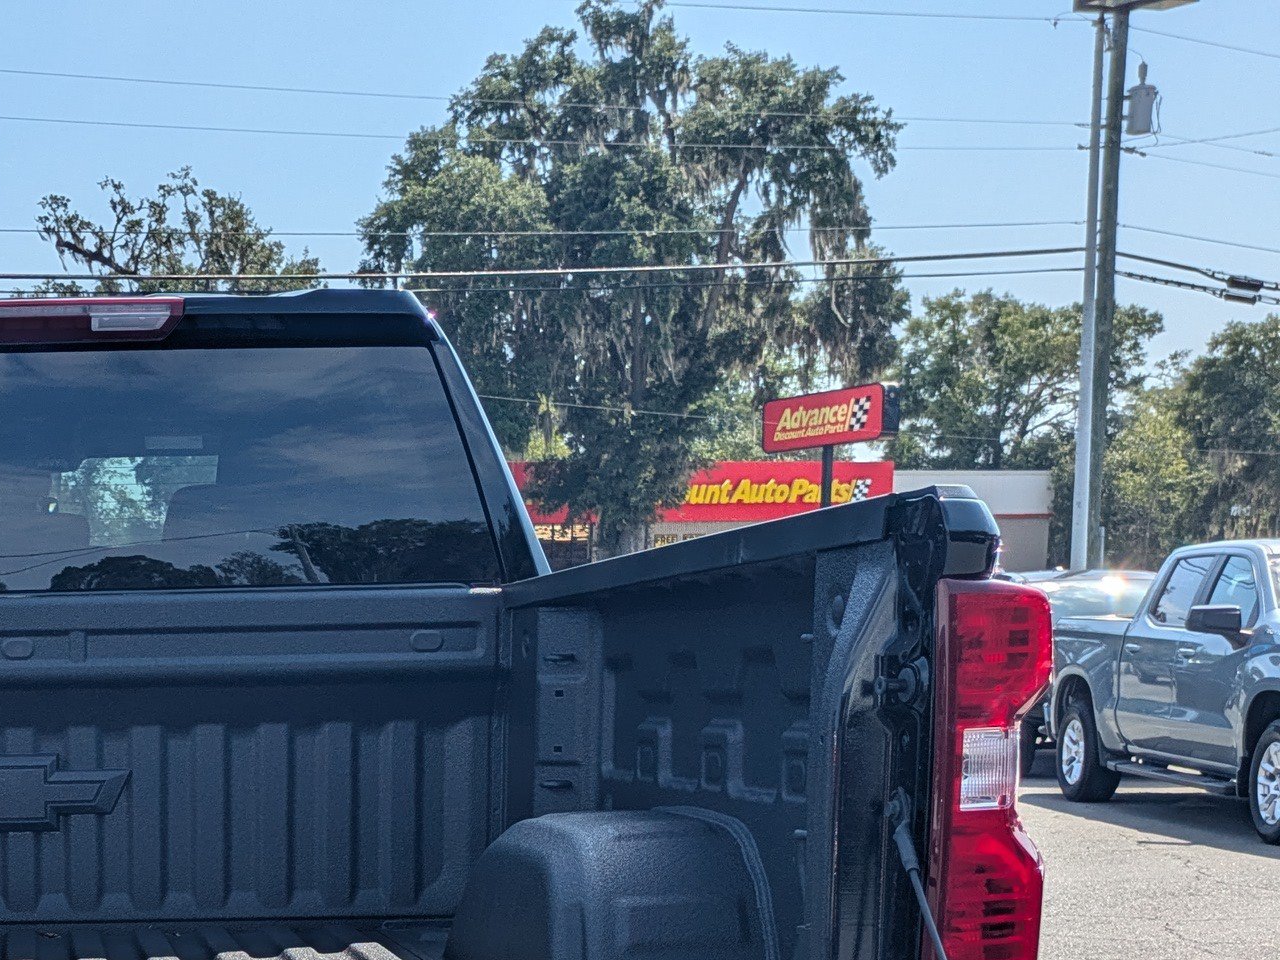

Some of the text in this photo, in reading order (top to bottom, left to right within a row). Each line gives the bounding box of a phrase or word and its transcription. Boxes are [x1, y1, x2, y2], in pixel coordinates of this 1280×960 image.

[776, 403, 848, 431] Advance
[773, 423, 845, 441] Discount Auto Parts
[686, 479, 733, 504] unt
[731, 478, 790, 503] Auto
